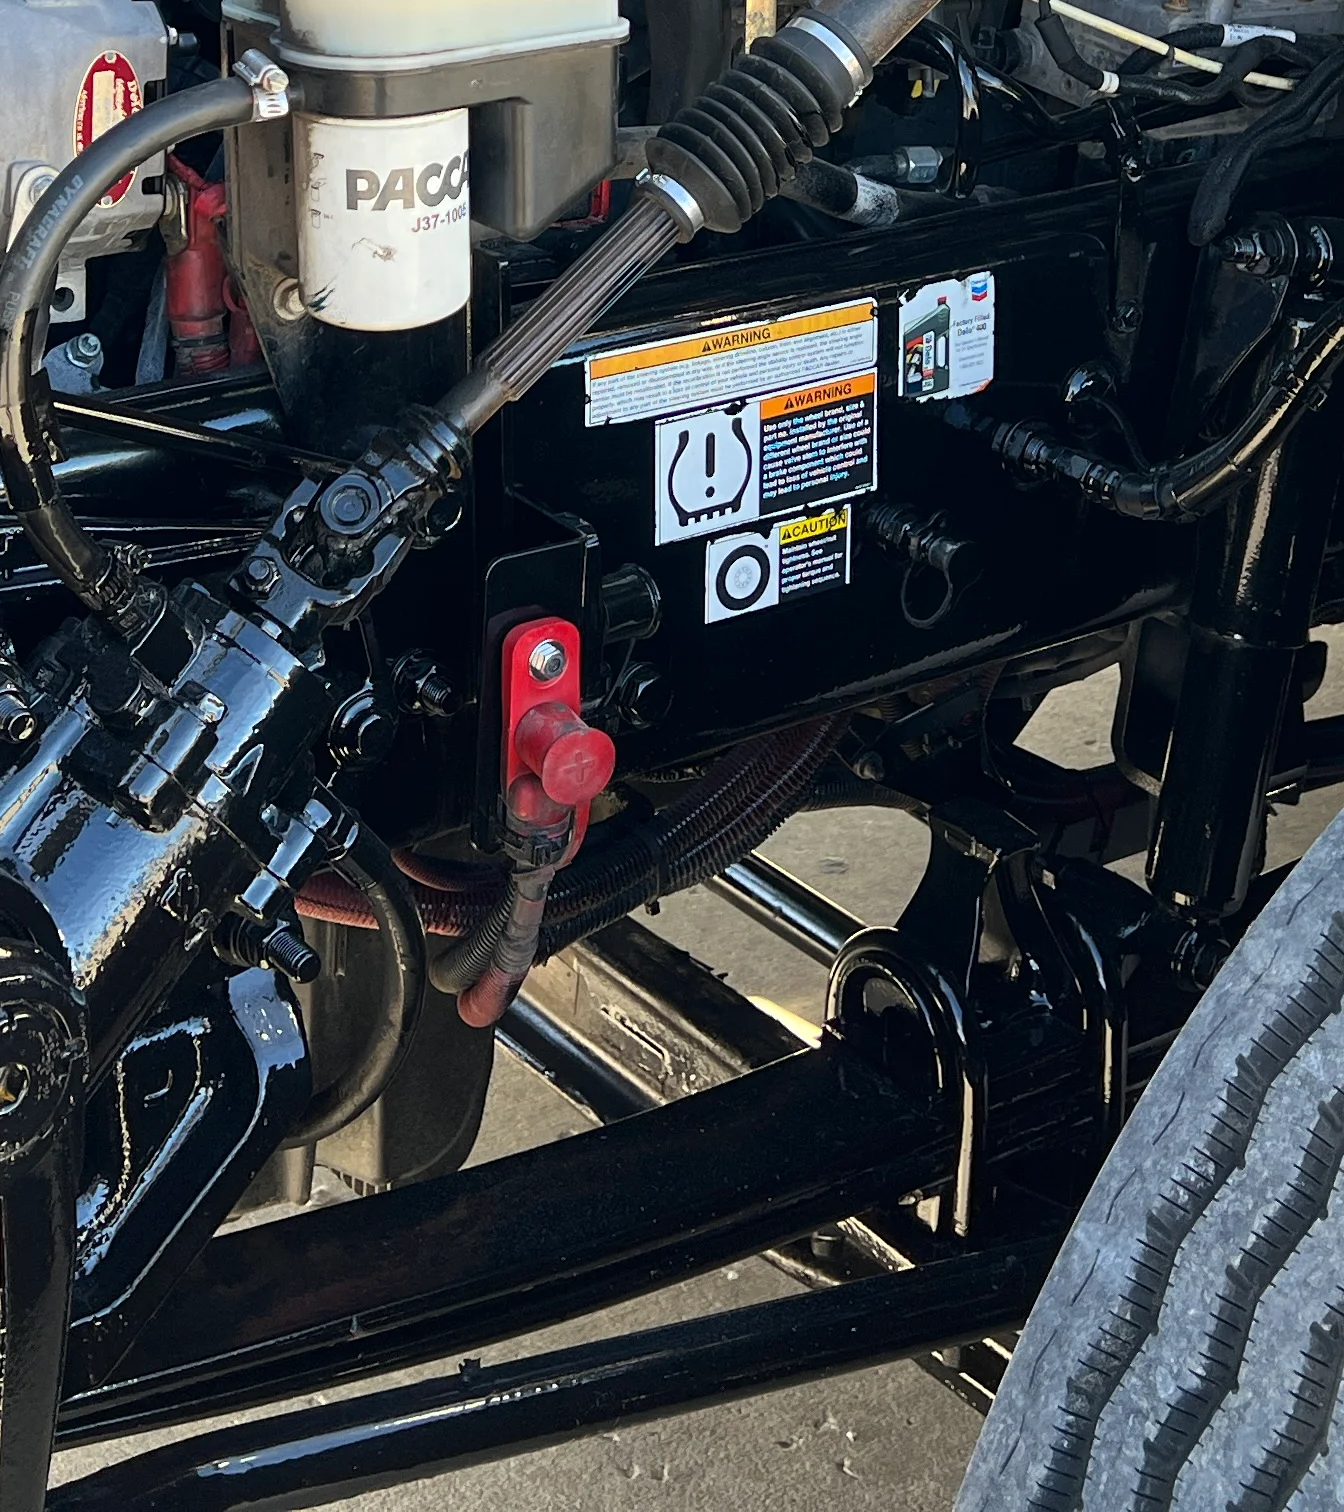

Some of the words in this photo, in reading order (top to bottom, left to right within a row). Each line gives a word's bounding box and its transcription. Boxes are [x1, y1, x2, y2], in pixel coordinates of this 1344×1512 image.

[712, 328, 771, 351] WARNING
[795, 383, 852, 408] WARNING
[792, 512, 846, 537] CAUTION
